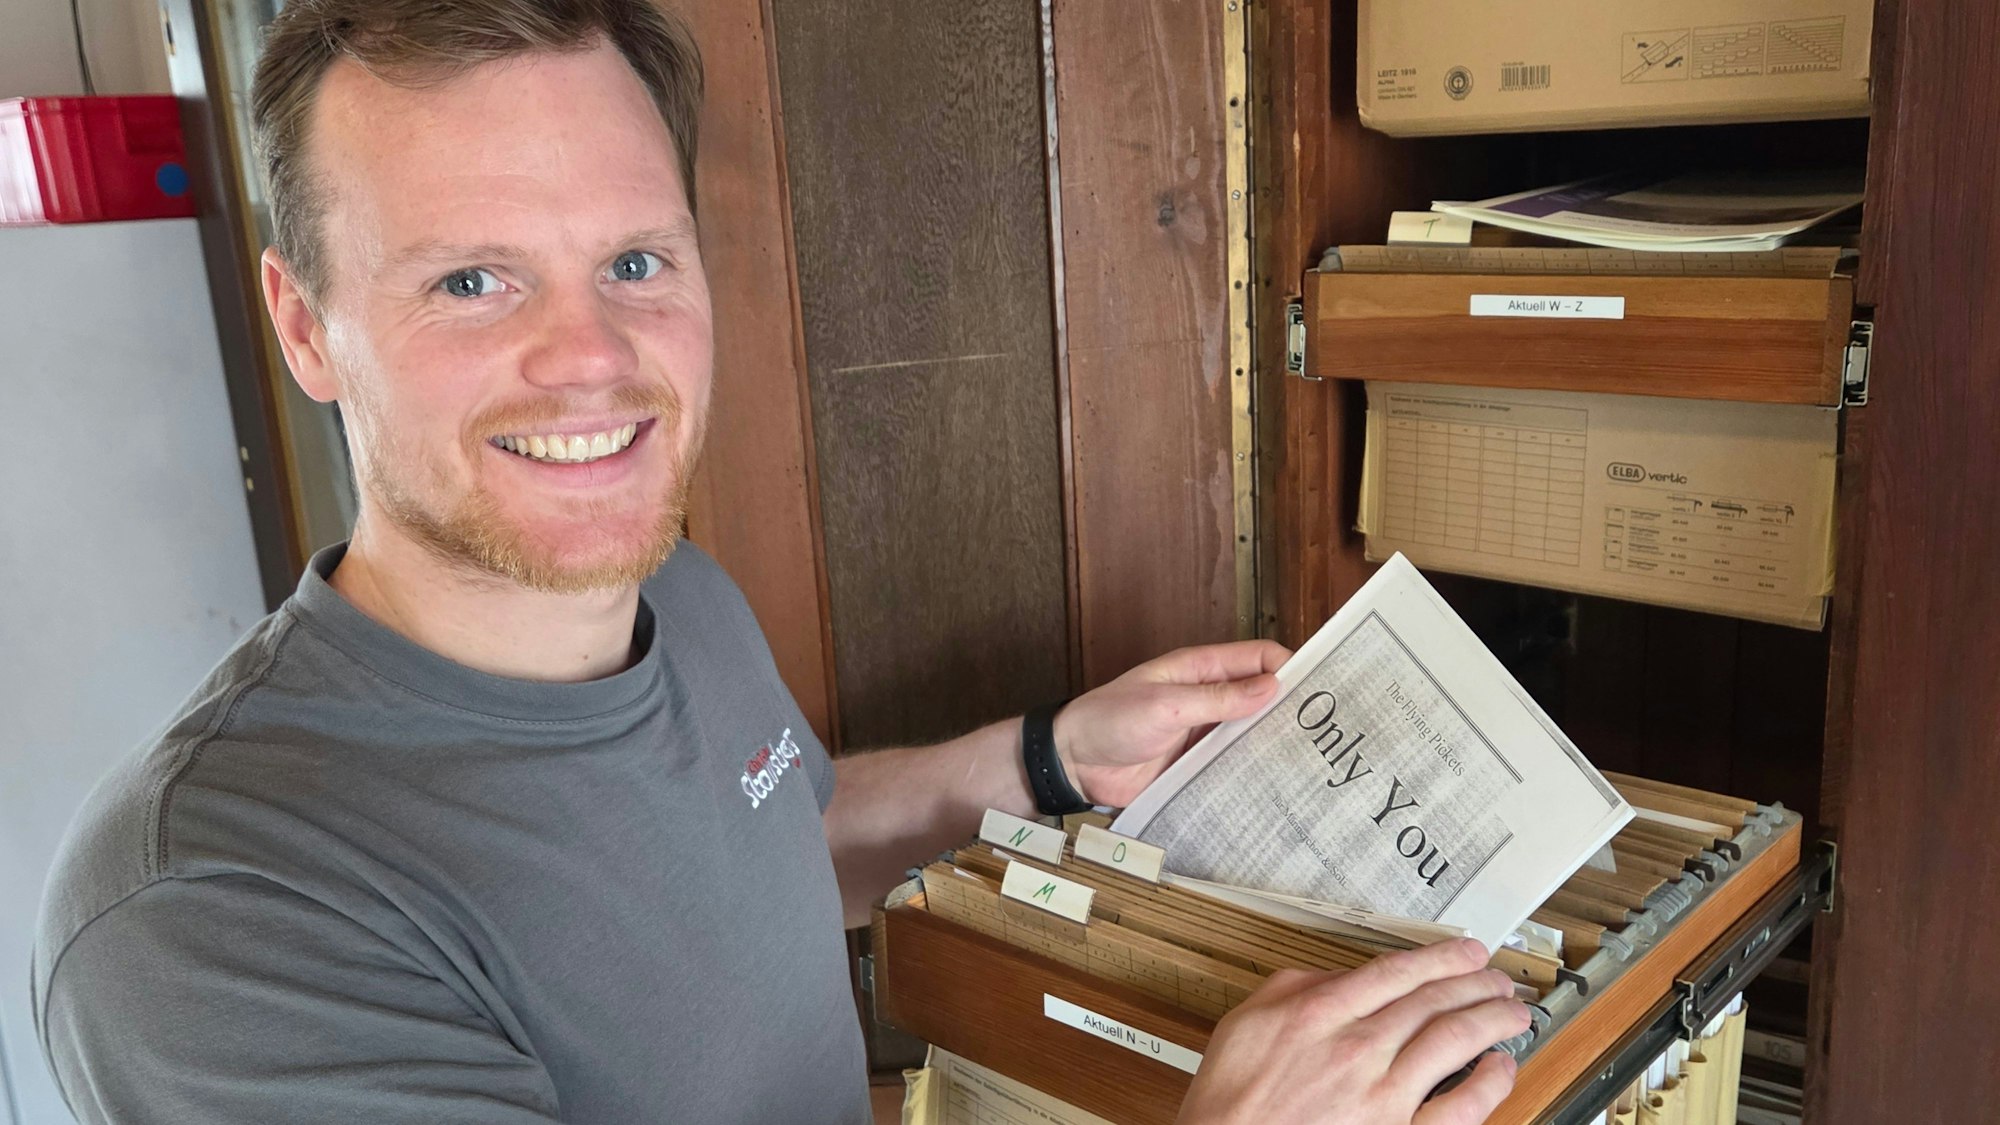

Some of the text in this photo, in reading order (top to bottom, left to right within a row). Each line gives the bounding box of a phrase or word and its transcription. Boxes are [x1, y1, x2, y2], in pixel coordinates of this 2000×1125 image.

[1377, 69, 1398, 77] LEITZ
[1423, 217, 1441, 238] T
[1507, 300, 1546, 311] Aktuell
[1549, 300, 1561, 311] W
[1575, 301, 1583, 312] Z
[1612, 466, 1688, 485] ELBA vertic
[1385, 678, 1466, 777] The Flying Pickets
[1296, 690, 1450, 889] Only You
[1008, 826, 1034, 847] N
[1112, 842, 1126, 863] O
[1321, 857, 1331, 870] &
[1032, 882, 1057, 904] M
[1083, 1014, 1123, 1039] Aktuell
[1126, 1030, 1136, 1045] N
[1151, 1039, 1161, 1054] U
